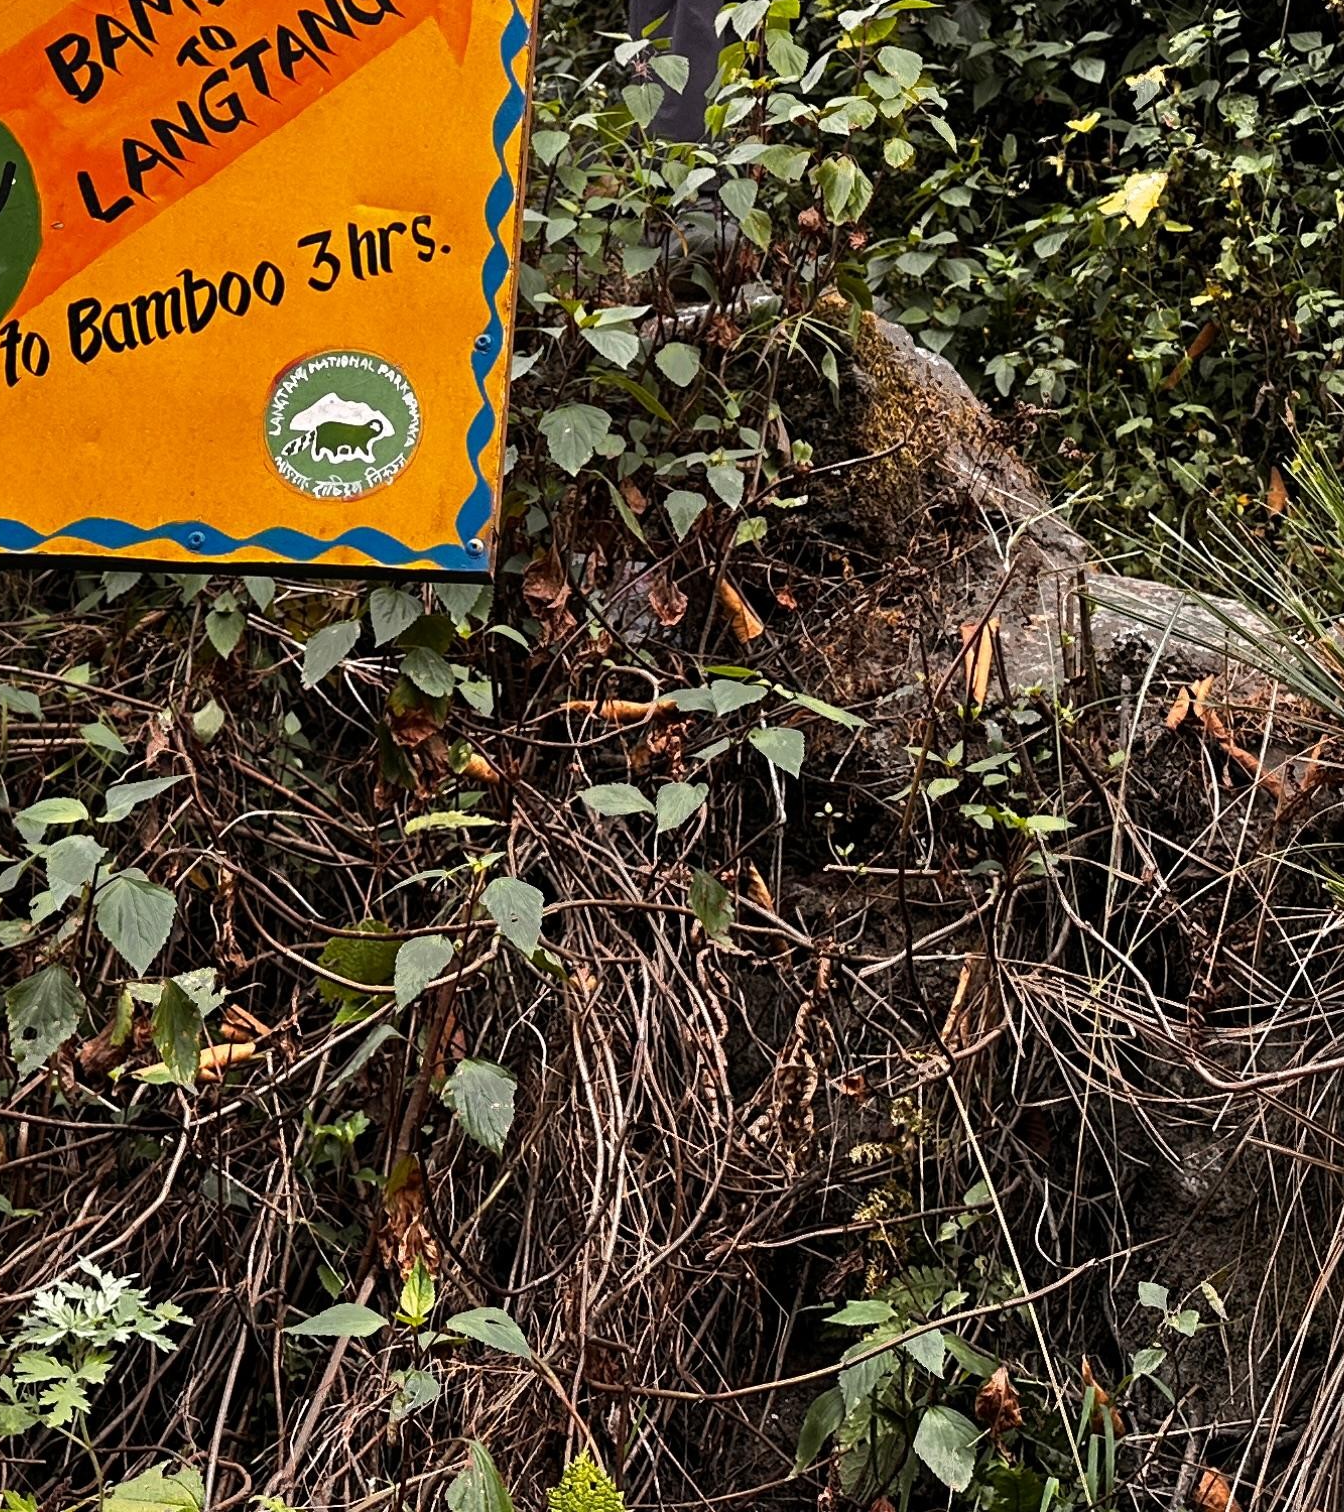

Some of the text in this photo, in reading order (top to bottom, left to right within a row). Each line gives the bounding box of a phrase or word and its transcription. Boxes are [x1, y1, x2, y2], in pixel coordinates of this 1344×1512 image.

[175, 24, 238, 68] TO
[66, 260, 286, 366] Bamboo
[297, 229, 342, 293] 3
[347, 214, 453, 281] hrs.
[308, 354, 375, 374] NATIONAL
[377, 363, 410, 394] PARK
